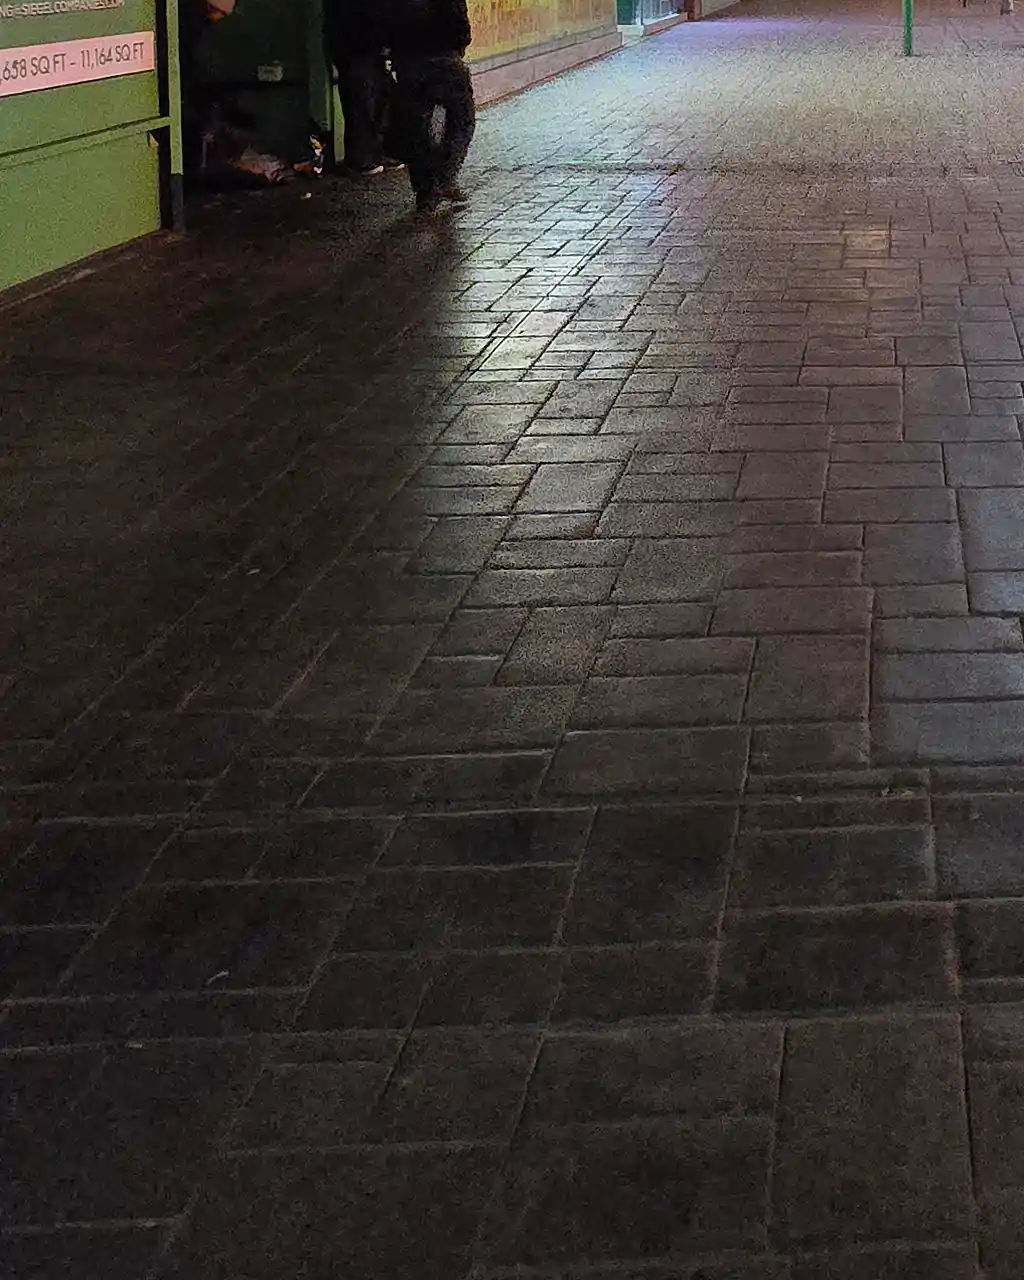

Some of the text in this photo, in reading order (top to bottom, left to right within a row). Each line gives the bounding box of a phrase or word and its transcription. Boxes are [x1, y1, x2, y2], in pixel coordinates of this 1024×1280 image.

[30, 55, 50, 77] SQ
[53, 52, 67, 73] FT
[80, 45, 112, 71] 11,164
[115, 43, 131, 63] SQ
[133, 41, 145, 60] FT
